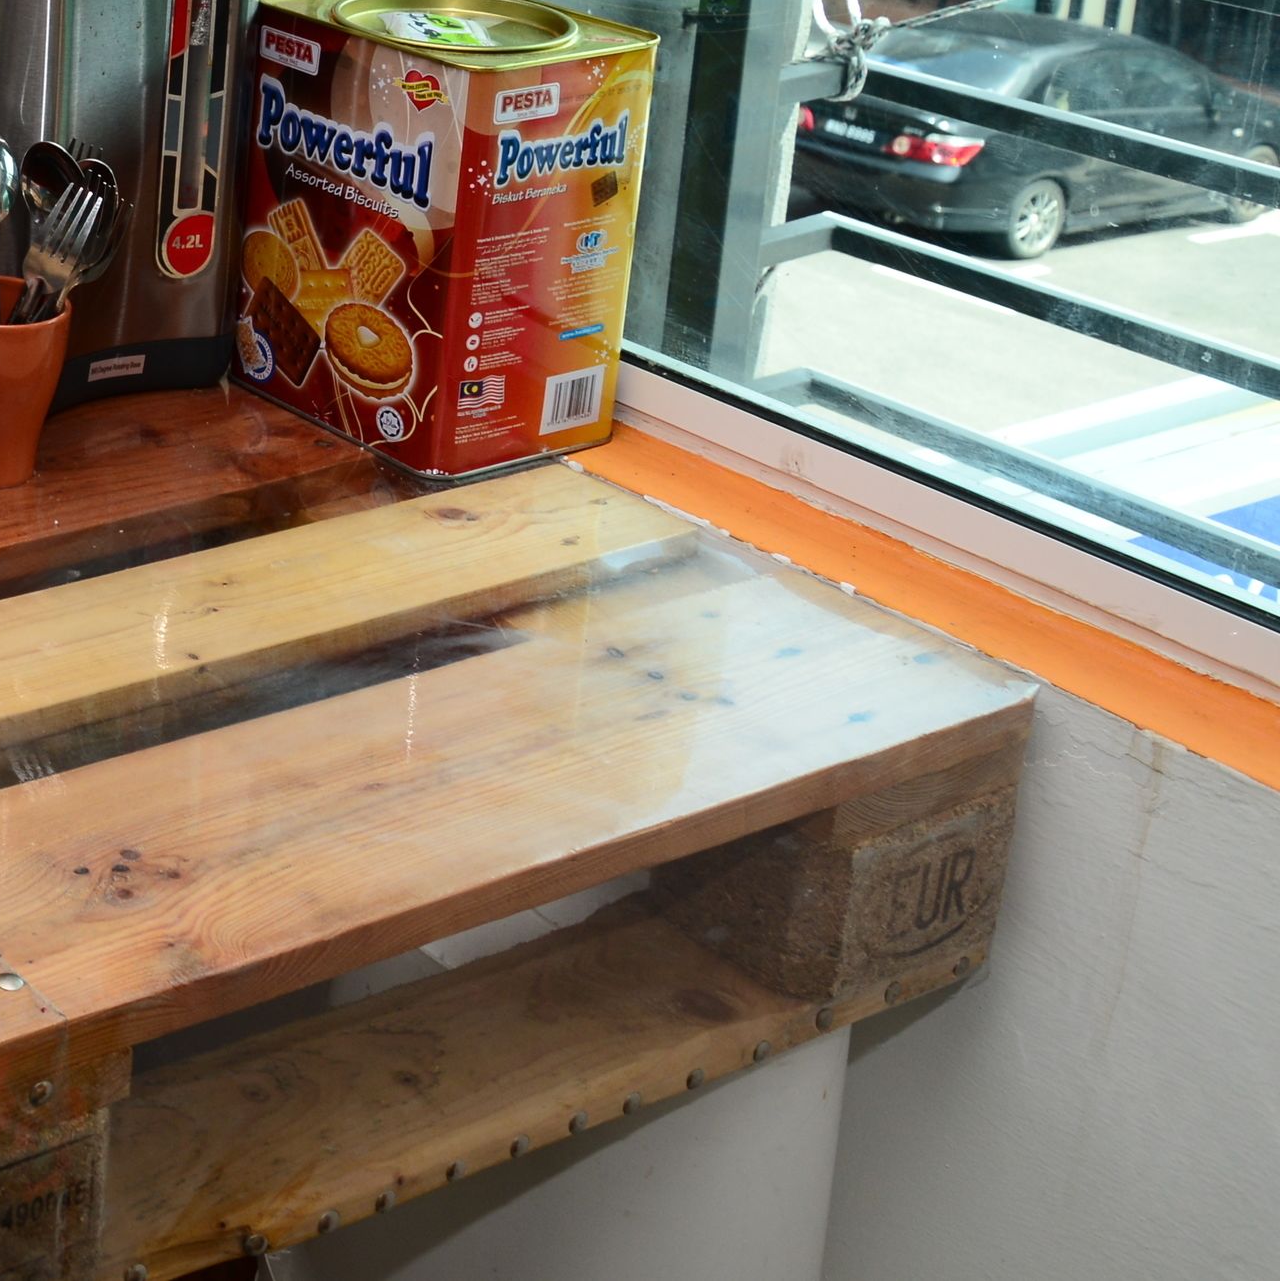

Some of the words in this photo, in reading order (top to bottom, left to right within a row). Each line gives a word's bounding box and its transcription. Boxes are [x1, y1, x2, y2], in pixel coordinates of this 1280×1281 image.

[264, 30, 314, 65] PESTA
[501, 89, 553, 114] PESTA
[258, 78, 434, 210] Powerful
[496, 114, 629, 186] Powerful
[285, 163, 343, 197] Assorted
[344, 184, 400, 219] Biscuits
[491, 190, 524, 205] Biskut
[171, 234, 204, 250] 4.2L
